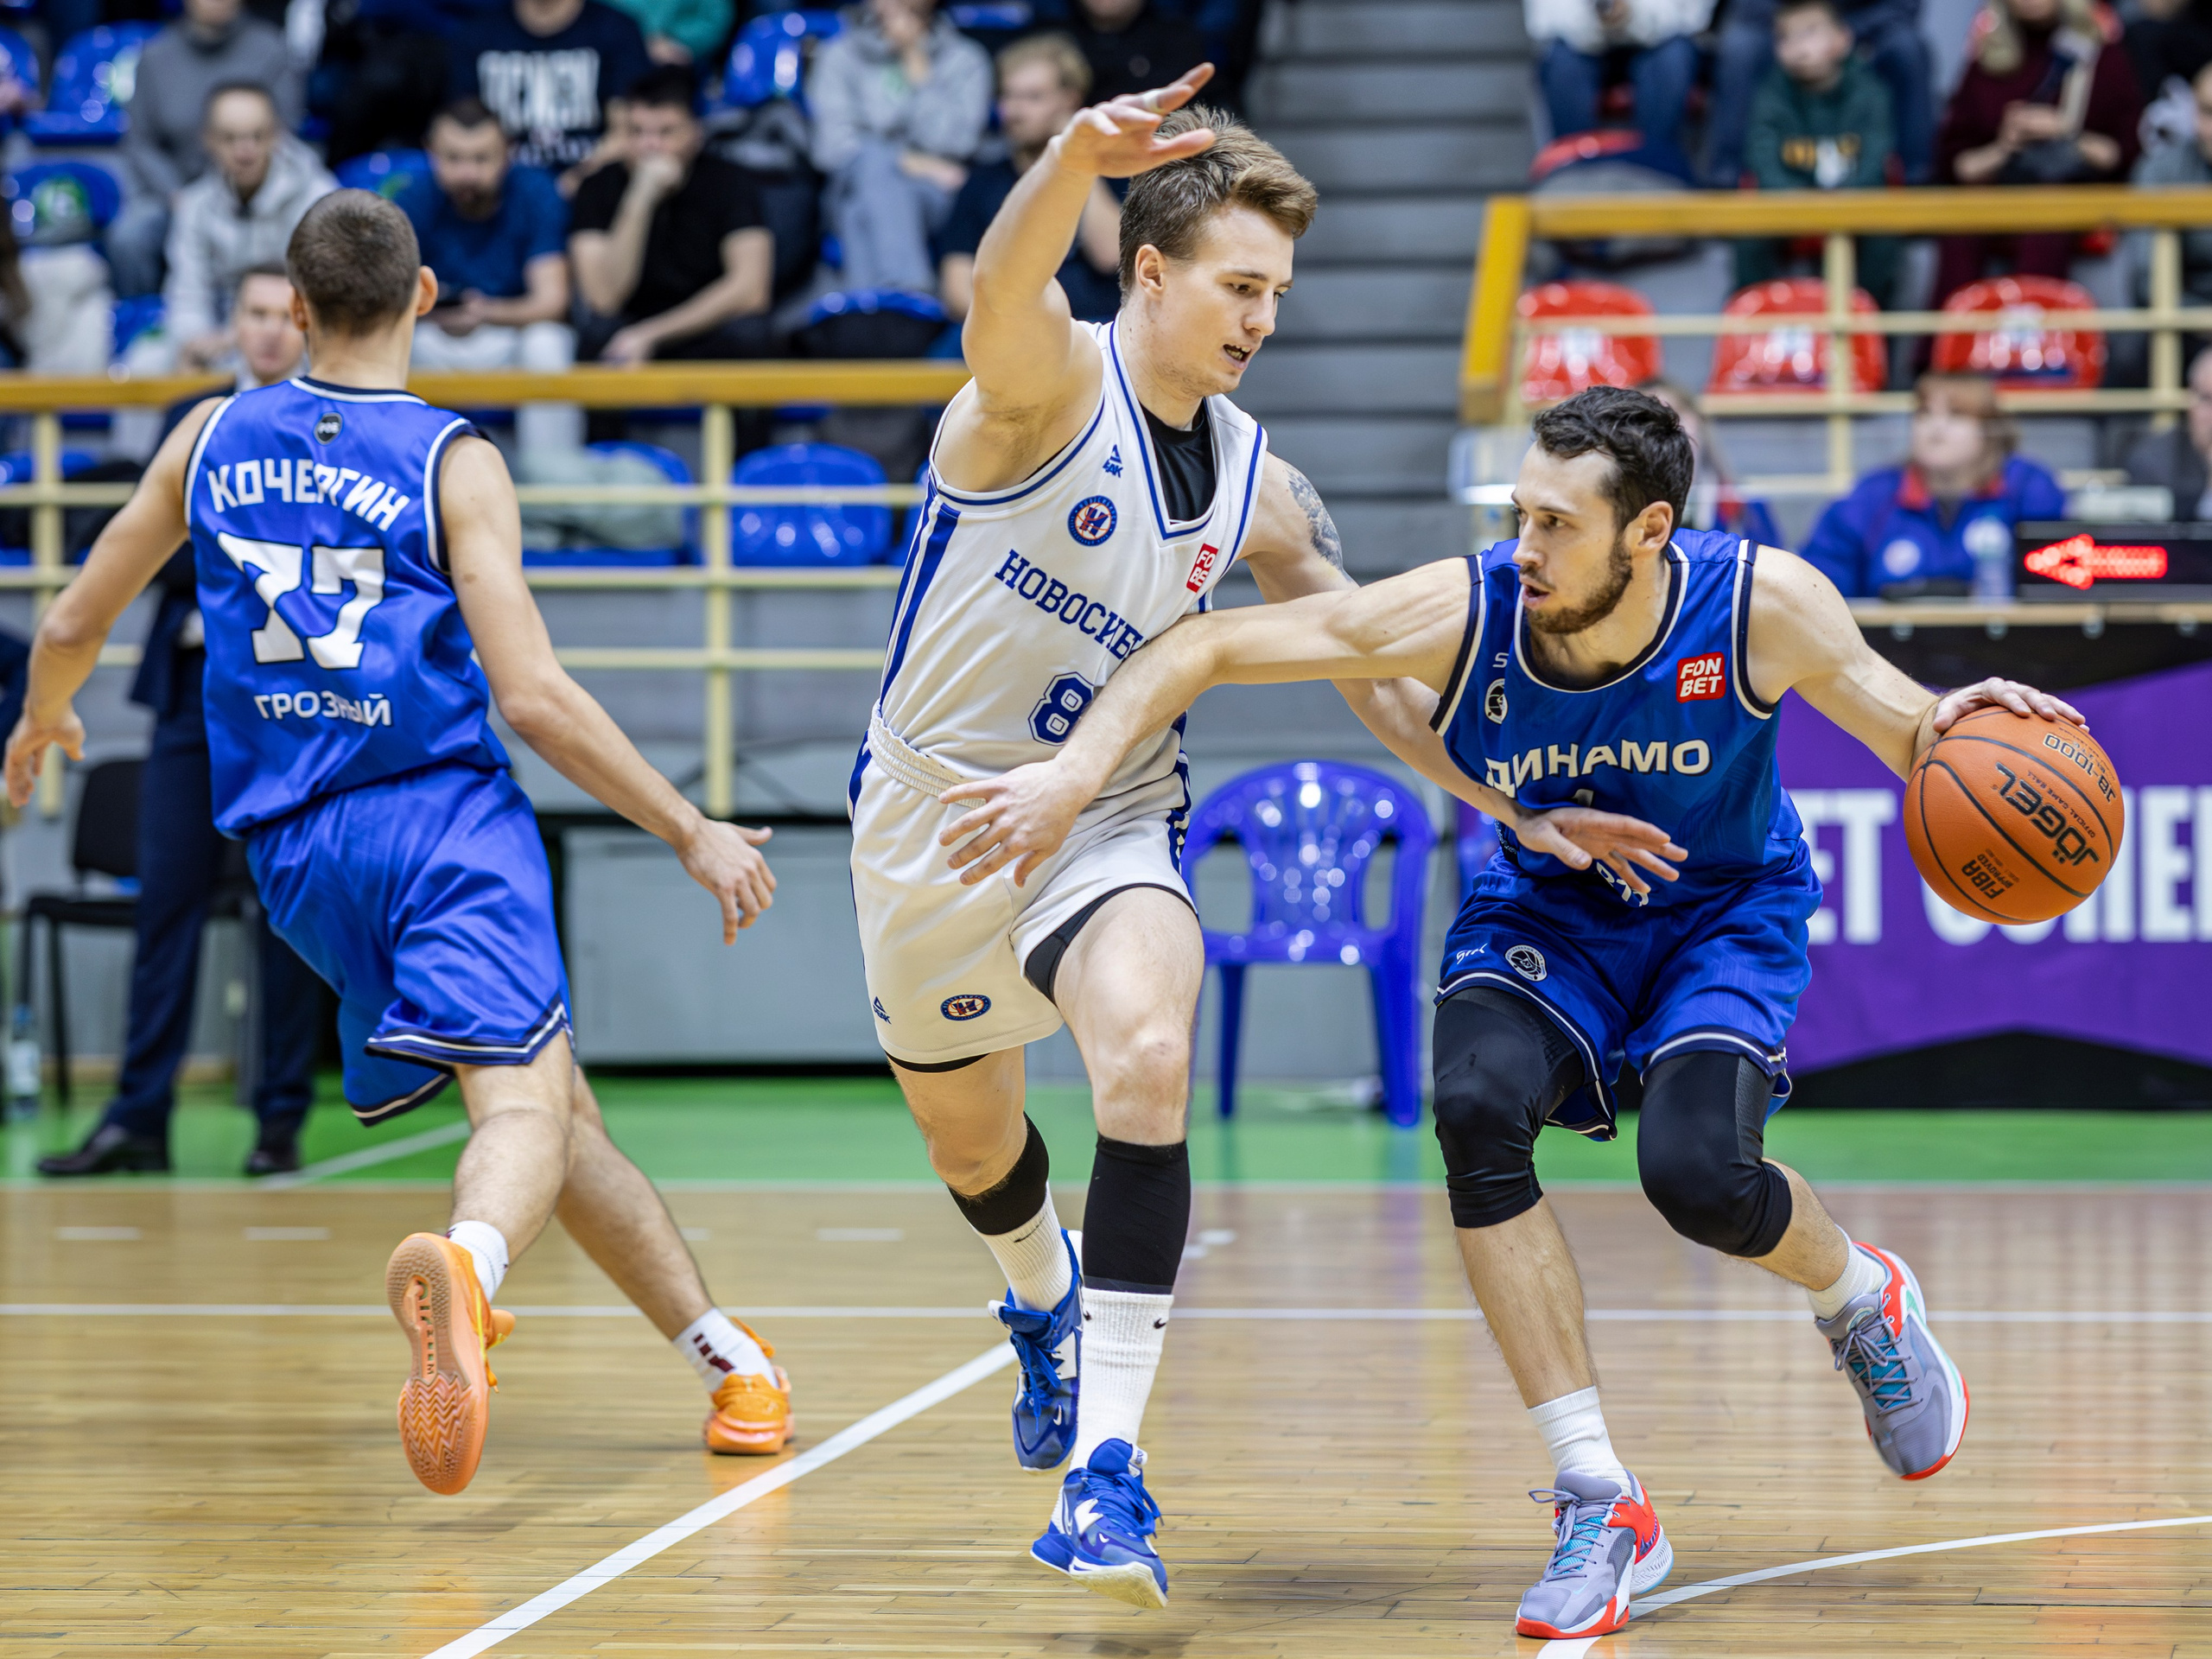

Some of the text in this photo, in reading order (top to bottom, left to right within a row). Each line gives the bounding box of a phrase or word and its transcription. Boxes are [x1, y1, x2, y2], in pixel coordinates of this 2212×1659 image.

[207, 458, 410, 532] КОЧЕРГИН
[217, 531, 386, 671] 77
[1679, 675, 1723, 697] BET
[1680, 657, 1722, 680] FON
[1484, 738, 1713, 800] ДИНАМО
[1994, 760, 2100, 867] JÖGEL
[2047, 787, 2069, 810] GAME
[1961, 859, 2005, 899] FIBA
